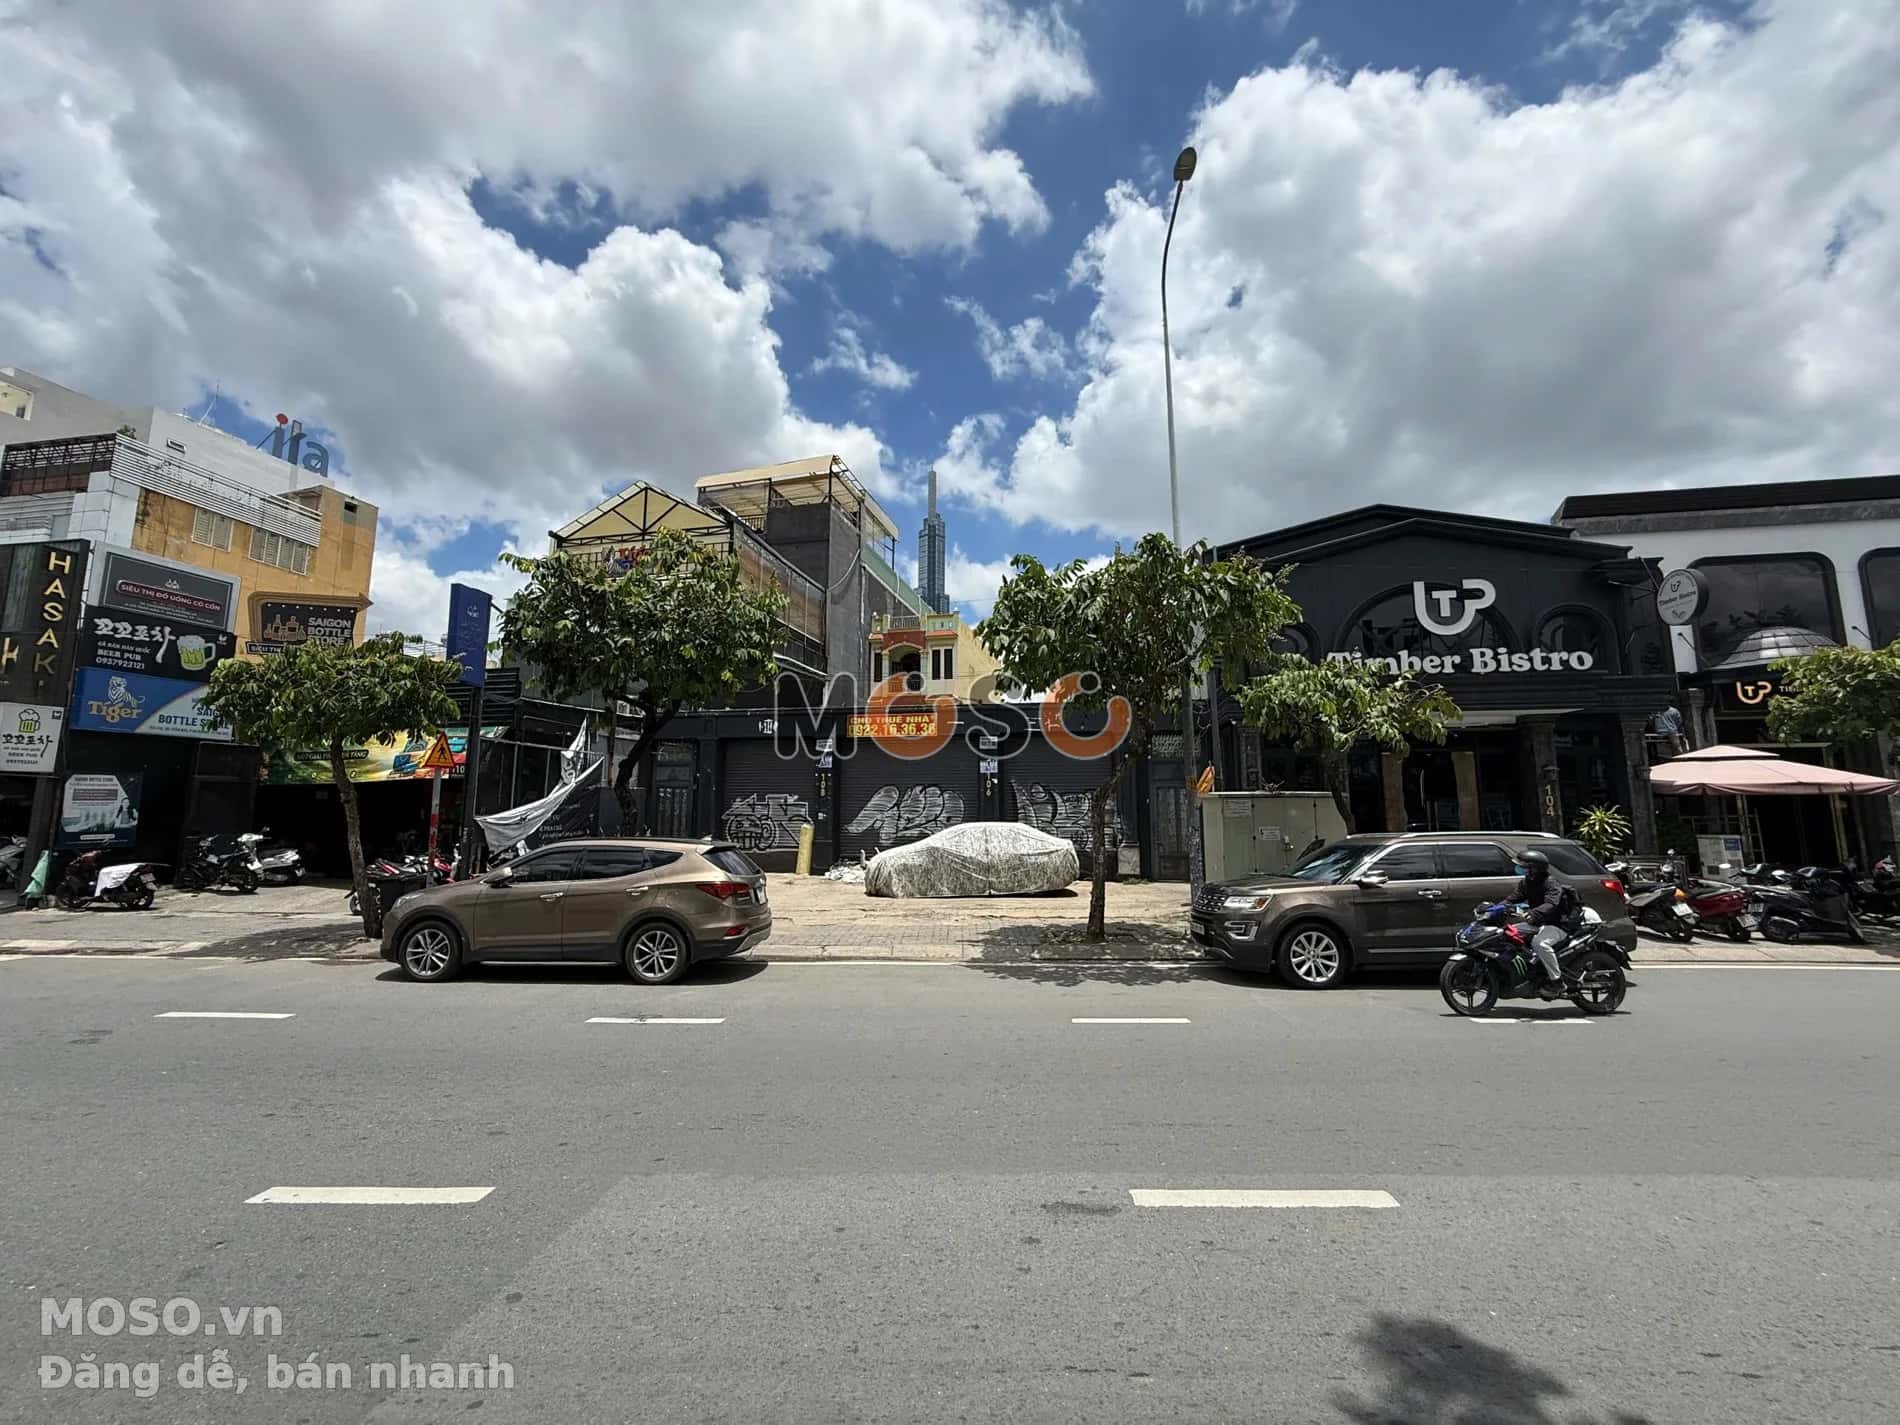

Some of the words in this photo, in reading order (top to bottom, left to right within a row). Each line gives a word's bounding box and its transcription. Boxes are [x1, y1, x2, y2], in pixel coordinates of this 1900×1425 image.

[307, 617, 352, 628] SAIGON
[307, 626, 352, 638] BOTTLE
[1469, 646, 1594, 674] Bistro
[87, 700, 144, 724] Tiger
[158, 713, 198, 728] BOTTLE
